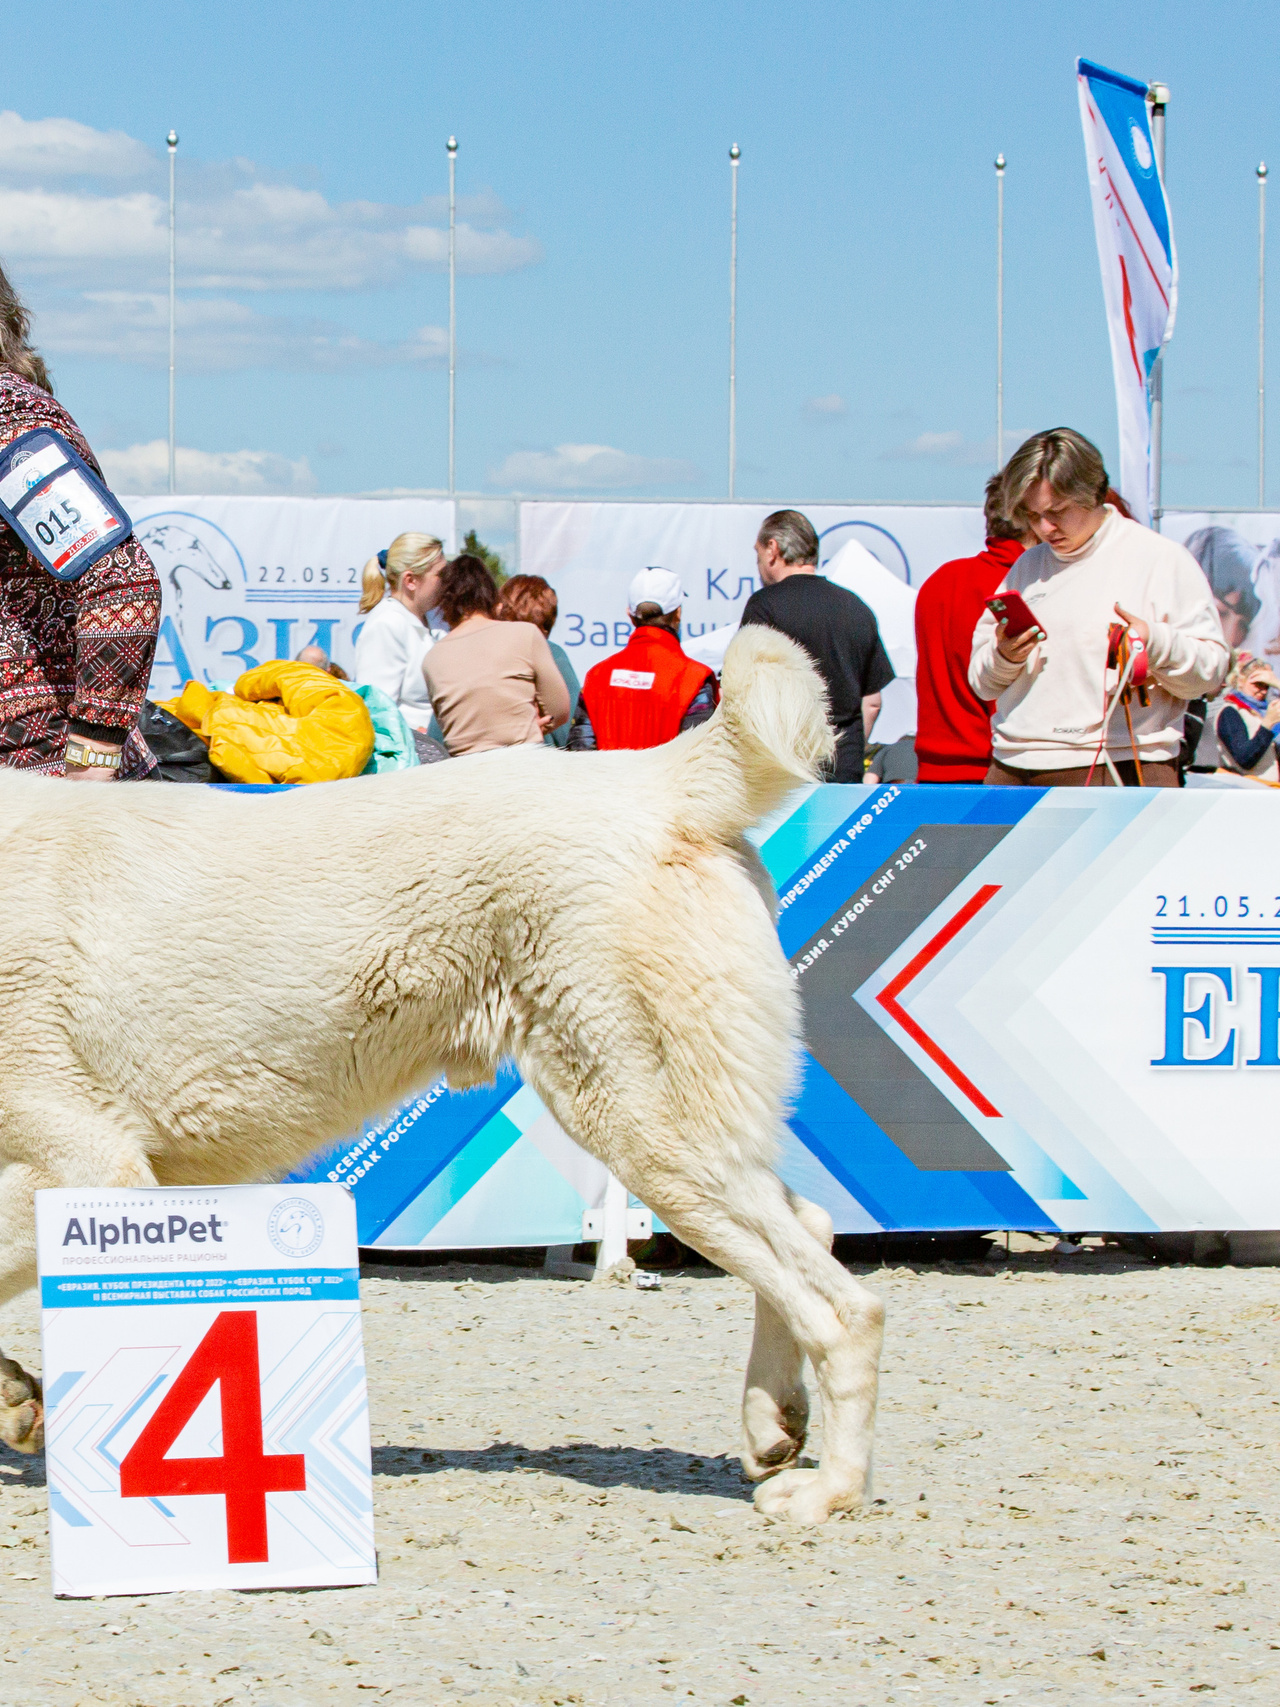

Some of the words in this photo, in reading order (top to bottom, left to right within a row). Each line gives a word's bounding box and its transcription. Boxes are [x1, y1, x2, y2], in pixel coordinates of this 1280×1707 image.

[35, 499, 82, 545] 015
[67, 528, 100, 556] 21.05.202
[259, 566, 358, 583] 22.05.2
[707, 568, 764, 600] Кл
[147, 615, 368, 691] АЗИ
[780, 839, 850, 908] ПРЕЗИДЕНТА
[846, 813, 873, 840] РКФ
[871, 786, 902, 815] 2022
[789, 938, 834, 979] РАЗИЯ.
[830, 894, 874, 936] КУБОК
[871, 869, 896, 894] СНГ
[895, 839, 927, 871] 2022
[380, 1074, 448, 1151] РОССИЙСК
[66, 1199, 154, 1209] ГЕНЕРАЛЬНЫЙ
[163, 1198, 219, 1206] СПОНСОР
[62, 1213, 223, 1253] AlphaPet
[62, 1253, 174, 1266] ПРОФЕССИОНАЛЬНЫЕ
[177, 1252, 228, 1263] РАЦИОНЫ
[101, 1291, 151, 1301] ВСЕМИРНАЯ
[152, 1290, 196, 1299] ВЫСТАВКА
[198, 1289, 224, 1298] СОБАК
[226, 1287, 281, 1297] РОССИЙСКИХ
[282, 1287, 312, 1296] ПОРОД
[102, 1281, 130, 1290] КУБОК
[131, 1280, 185, 1289] ПРЕЗИДЕНТА
[186, 1279, 204, 1287] РКФ
[277, 1276, 305, 1285] КУБОК
[307, 1276, 323, 1284] СНГ
[120, 1310, 306, 1564] 4
